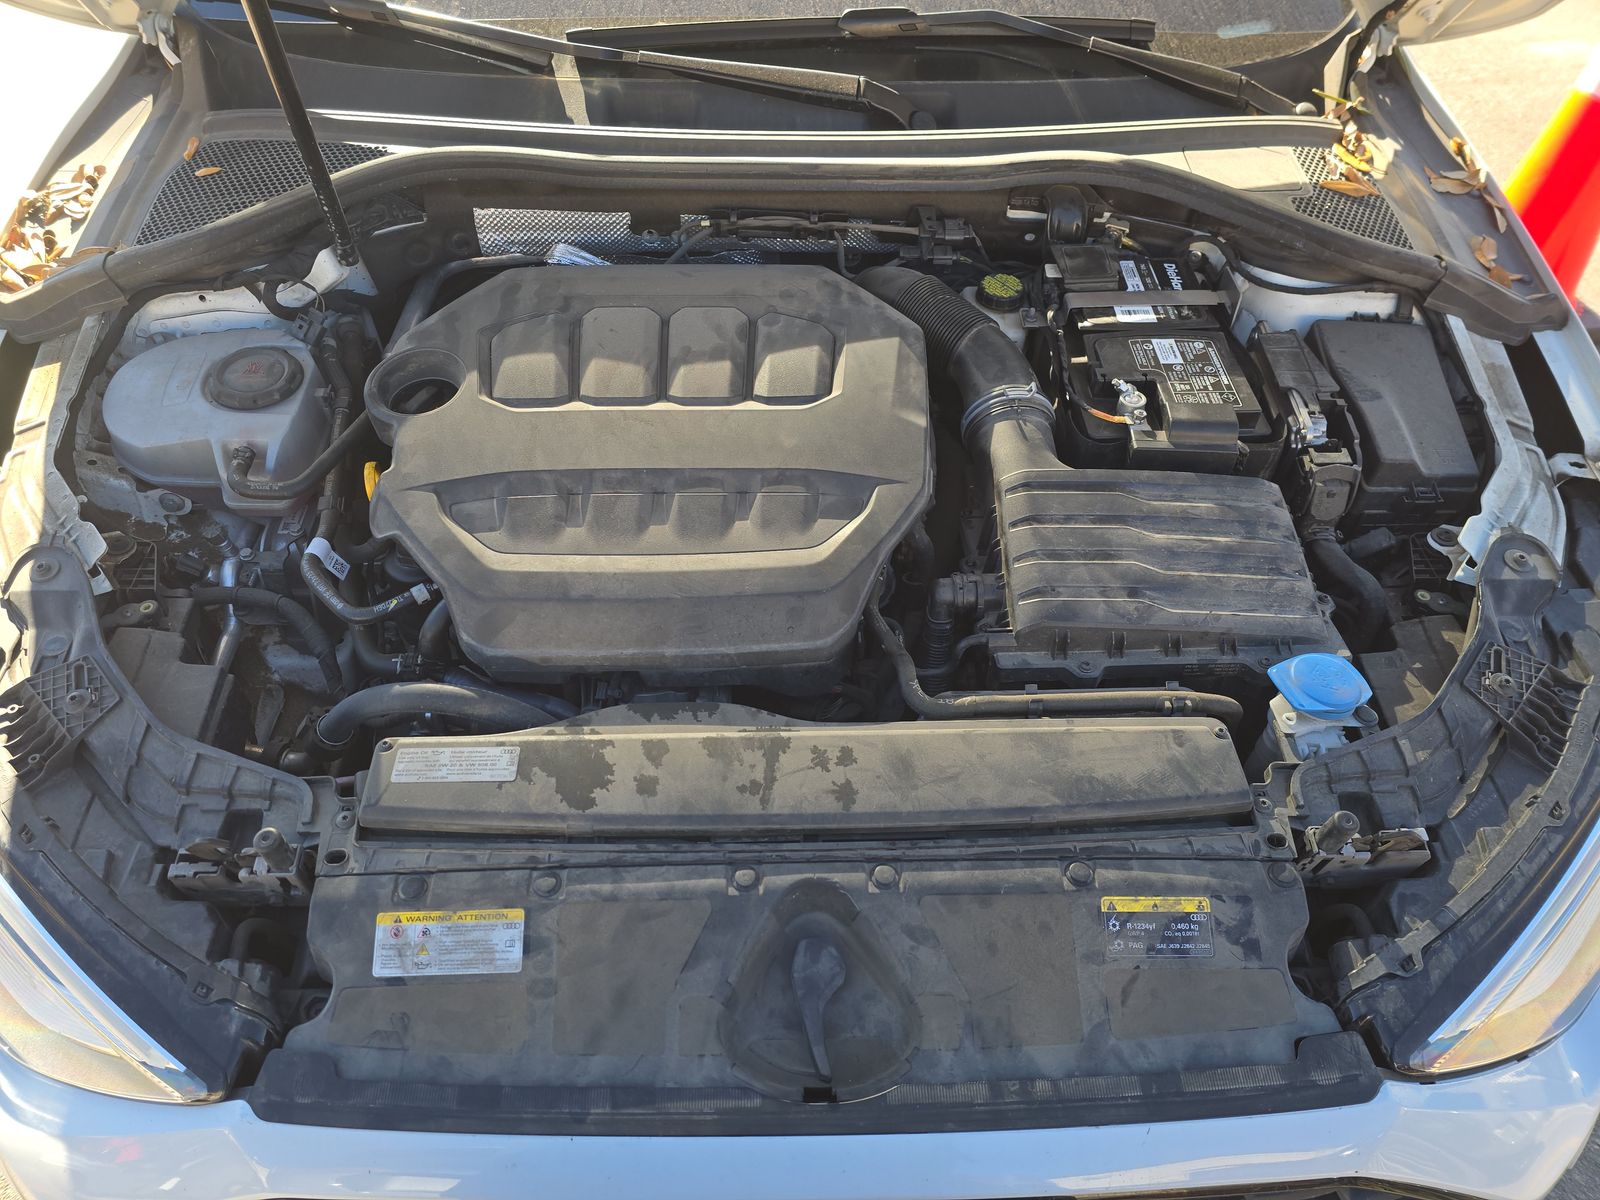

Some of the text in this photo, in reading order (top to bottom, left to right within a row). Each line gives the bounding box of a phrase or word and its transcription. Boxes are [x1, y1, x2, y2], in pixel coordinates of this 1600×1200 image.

[1163, 263, 1183, 291] DieHar
[406, 912, 509, 923] WARNING ATTENTION
[1126, 923, 1156, 931] R-1234yf
[1190, 922, 1199, 931] kg
[1128, 941, 1144, 949] PAG
